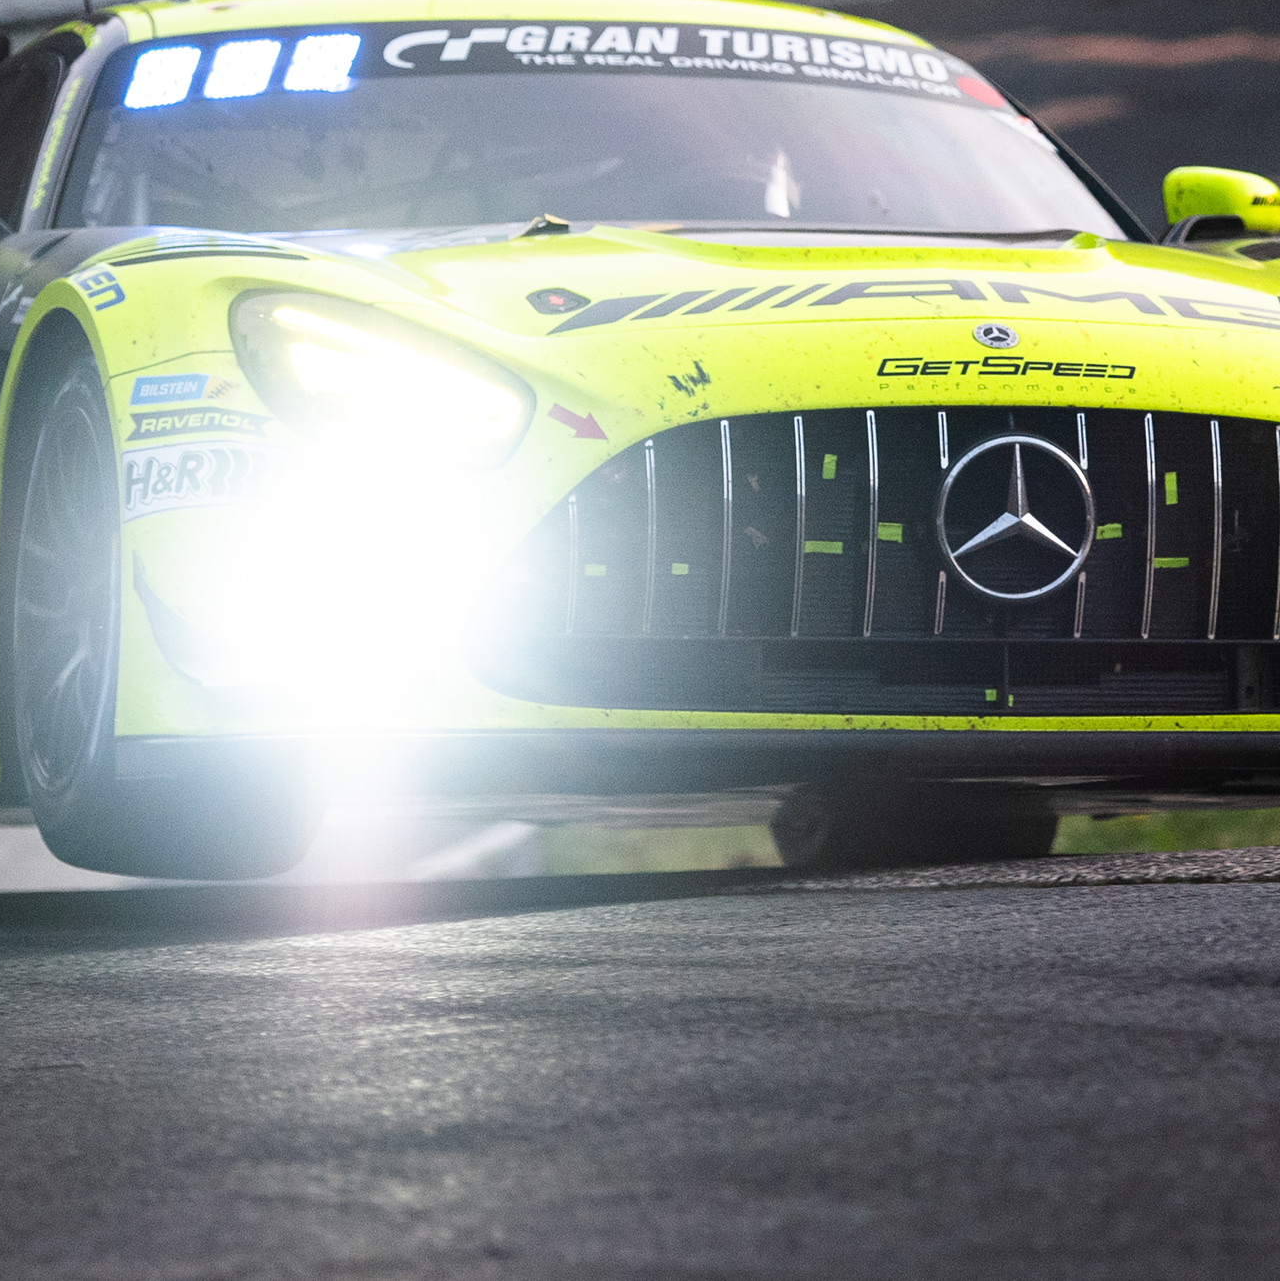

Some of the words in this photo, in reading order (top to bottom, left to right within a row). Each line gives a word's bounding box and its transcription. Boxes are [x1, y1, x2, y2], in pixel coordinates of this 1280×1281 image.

[505, 25, 680, 54] GRAN
[698, 28, 950, 83] TURISMO
[515, 53, 577, 65] THE
[583, 54, 664, 68] REAL
[669, 55, 795, 75] DRIVING
[800, 64, 962, 99] SIMULATOR
[139, 380, 199, 398] BILSTEIN
[140, 412, 257, 434] RAVENOL
[124, 449, 206, 508] H&R
